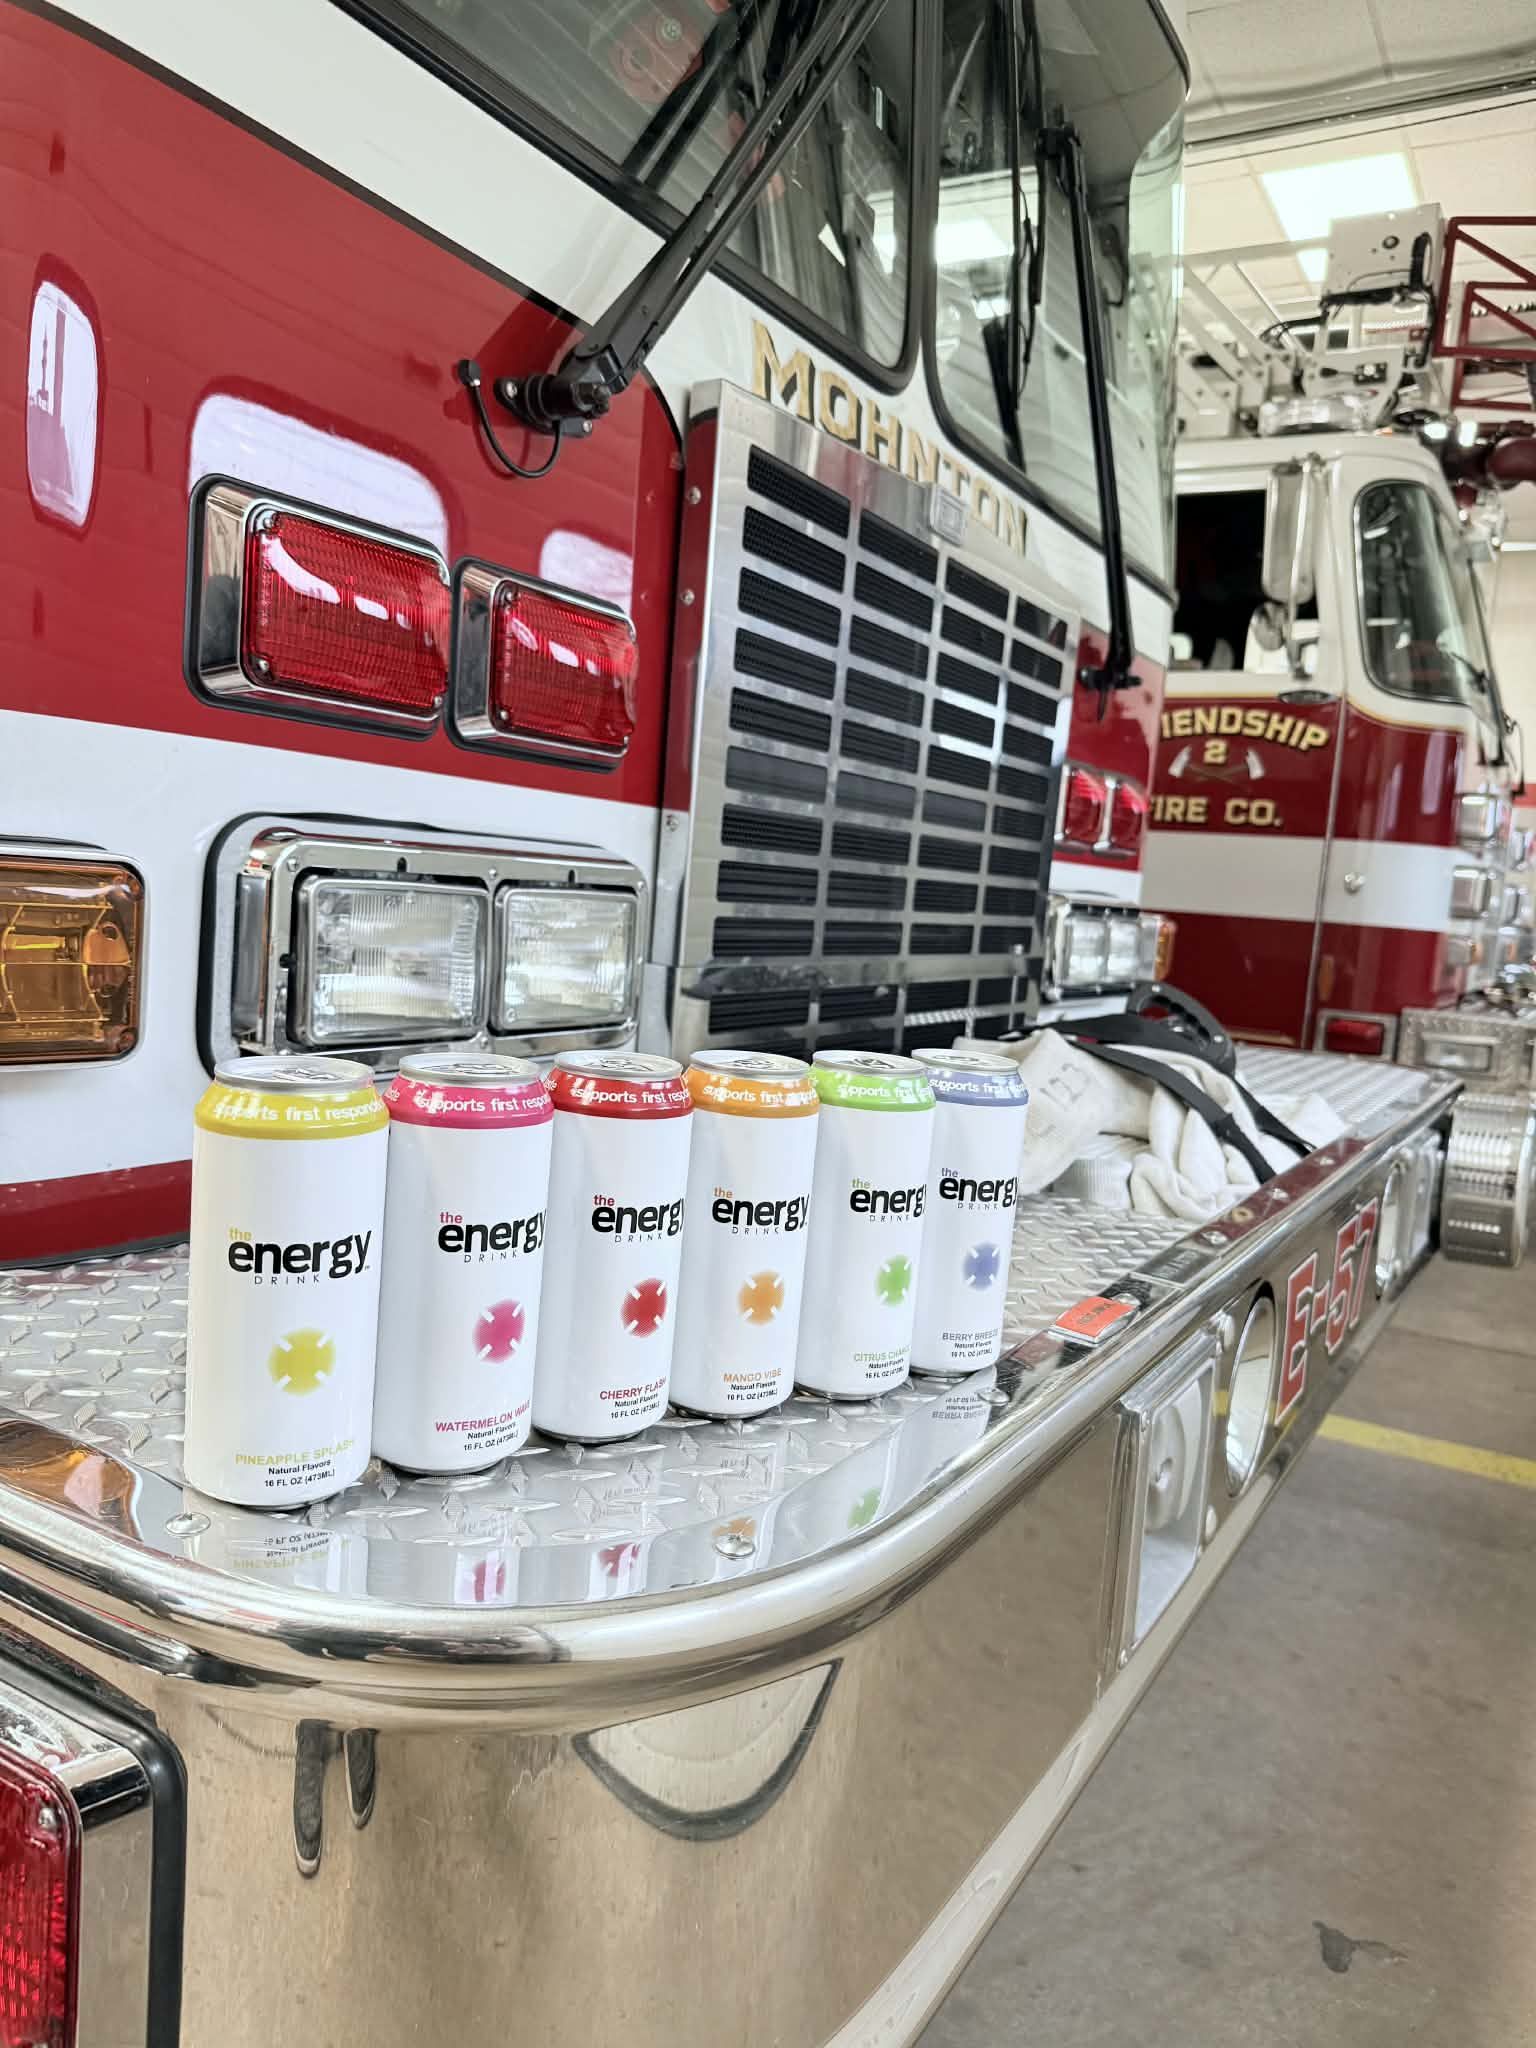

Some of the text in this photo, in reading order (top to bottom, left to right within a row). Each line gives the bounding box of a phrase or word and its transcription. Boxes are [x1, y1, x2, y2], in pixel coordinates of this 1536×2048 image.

[752, 319, 1028, 556] MOHNTON
[1160, 706, 1330, 751] IENDSHIP
[1203, 739, 1228, 765] 2
[1150, 796, 1283, 827] IRE CO.
[642, 1091, 666, 1104] first
[491, 1098, 519, 1112] first
[285, 1104, 321, 1121] first
[941, 1167, 959, 1178] the
[852, 1178, 871, 1190] the
[714, 1187, 733, 1199] the
[594, 1194, 615, 1207] the
[957, 1202, 999, 1211] DRINK
[440, 1211, 463, 1224] the
[712, 1193, 810, 1232] energy
[229, 1227, 252, 1241] the
[438, 1208, 547, 1254] energy
[731, 1226, 780, 1236] DRINK
[614, 1233, 662, 1243] DRINK
[228, 1230, 372, 1279] energy
[464, 1251, 518, 1264] DRINK
[254, 1274, 321, 1285] DRINK
[1273, 1196, 1379, 1428] E-57
[942, 1332, 974, 1341] BERRY
[854, 1351, 886, 1362] CITRUS
[723, 1367, 782, 1383] MANGO VIBE
[599, 1385, 644, 1400] CHERRY
[730, 1383, 755, 1391] Natural
[746, 1392, 756, 1400] OZ
[614, 1397, 639, 1409] Natural
[620, 1410, 629, 1418] FL
[630, 1408, 640, 1417] OZ
[435, 1410, 514, 1433] WATERMELON
[467, 1428, 494, 1441] Natural
[474, 1442, 483, 1450] FL
[485, 1439, 496, 1449] OZ
[235, 1452, 310, 1466] PINEAPPLE
[268, 1459, 332, 1476] Natural Flavors
[264, 1479, 275, 1488] 16
[276, 1478, 288, 1487] FL
[290, 1476, 303, 1486] OZ
